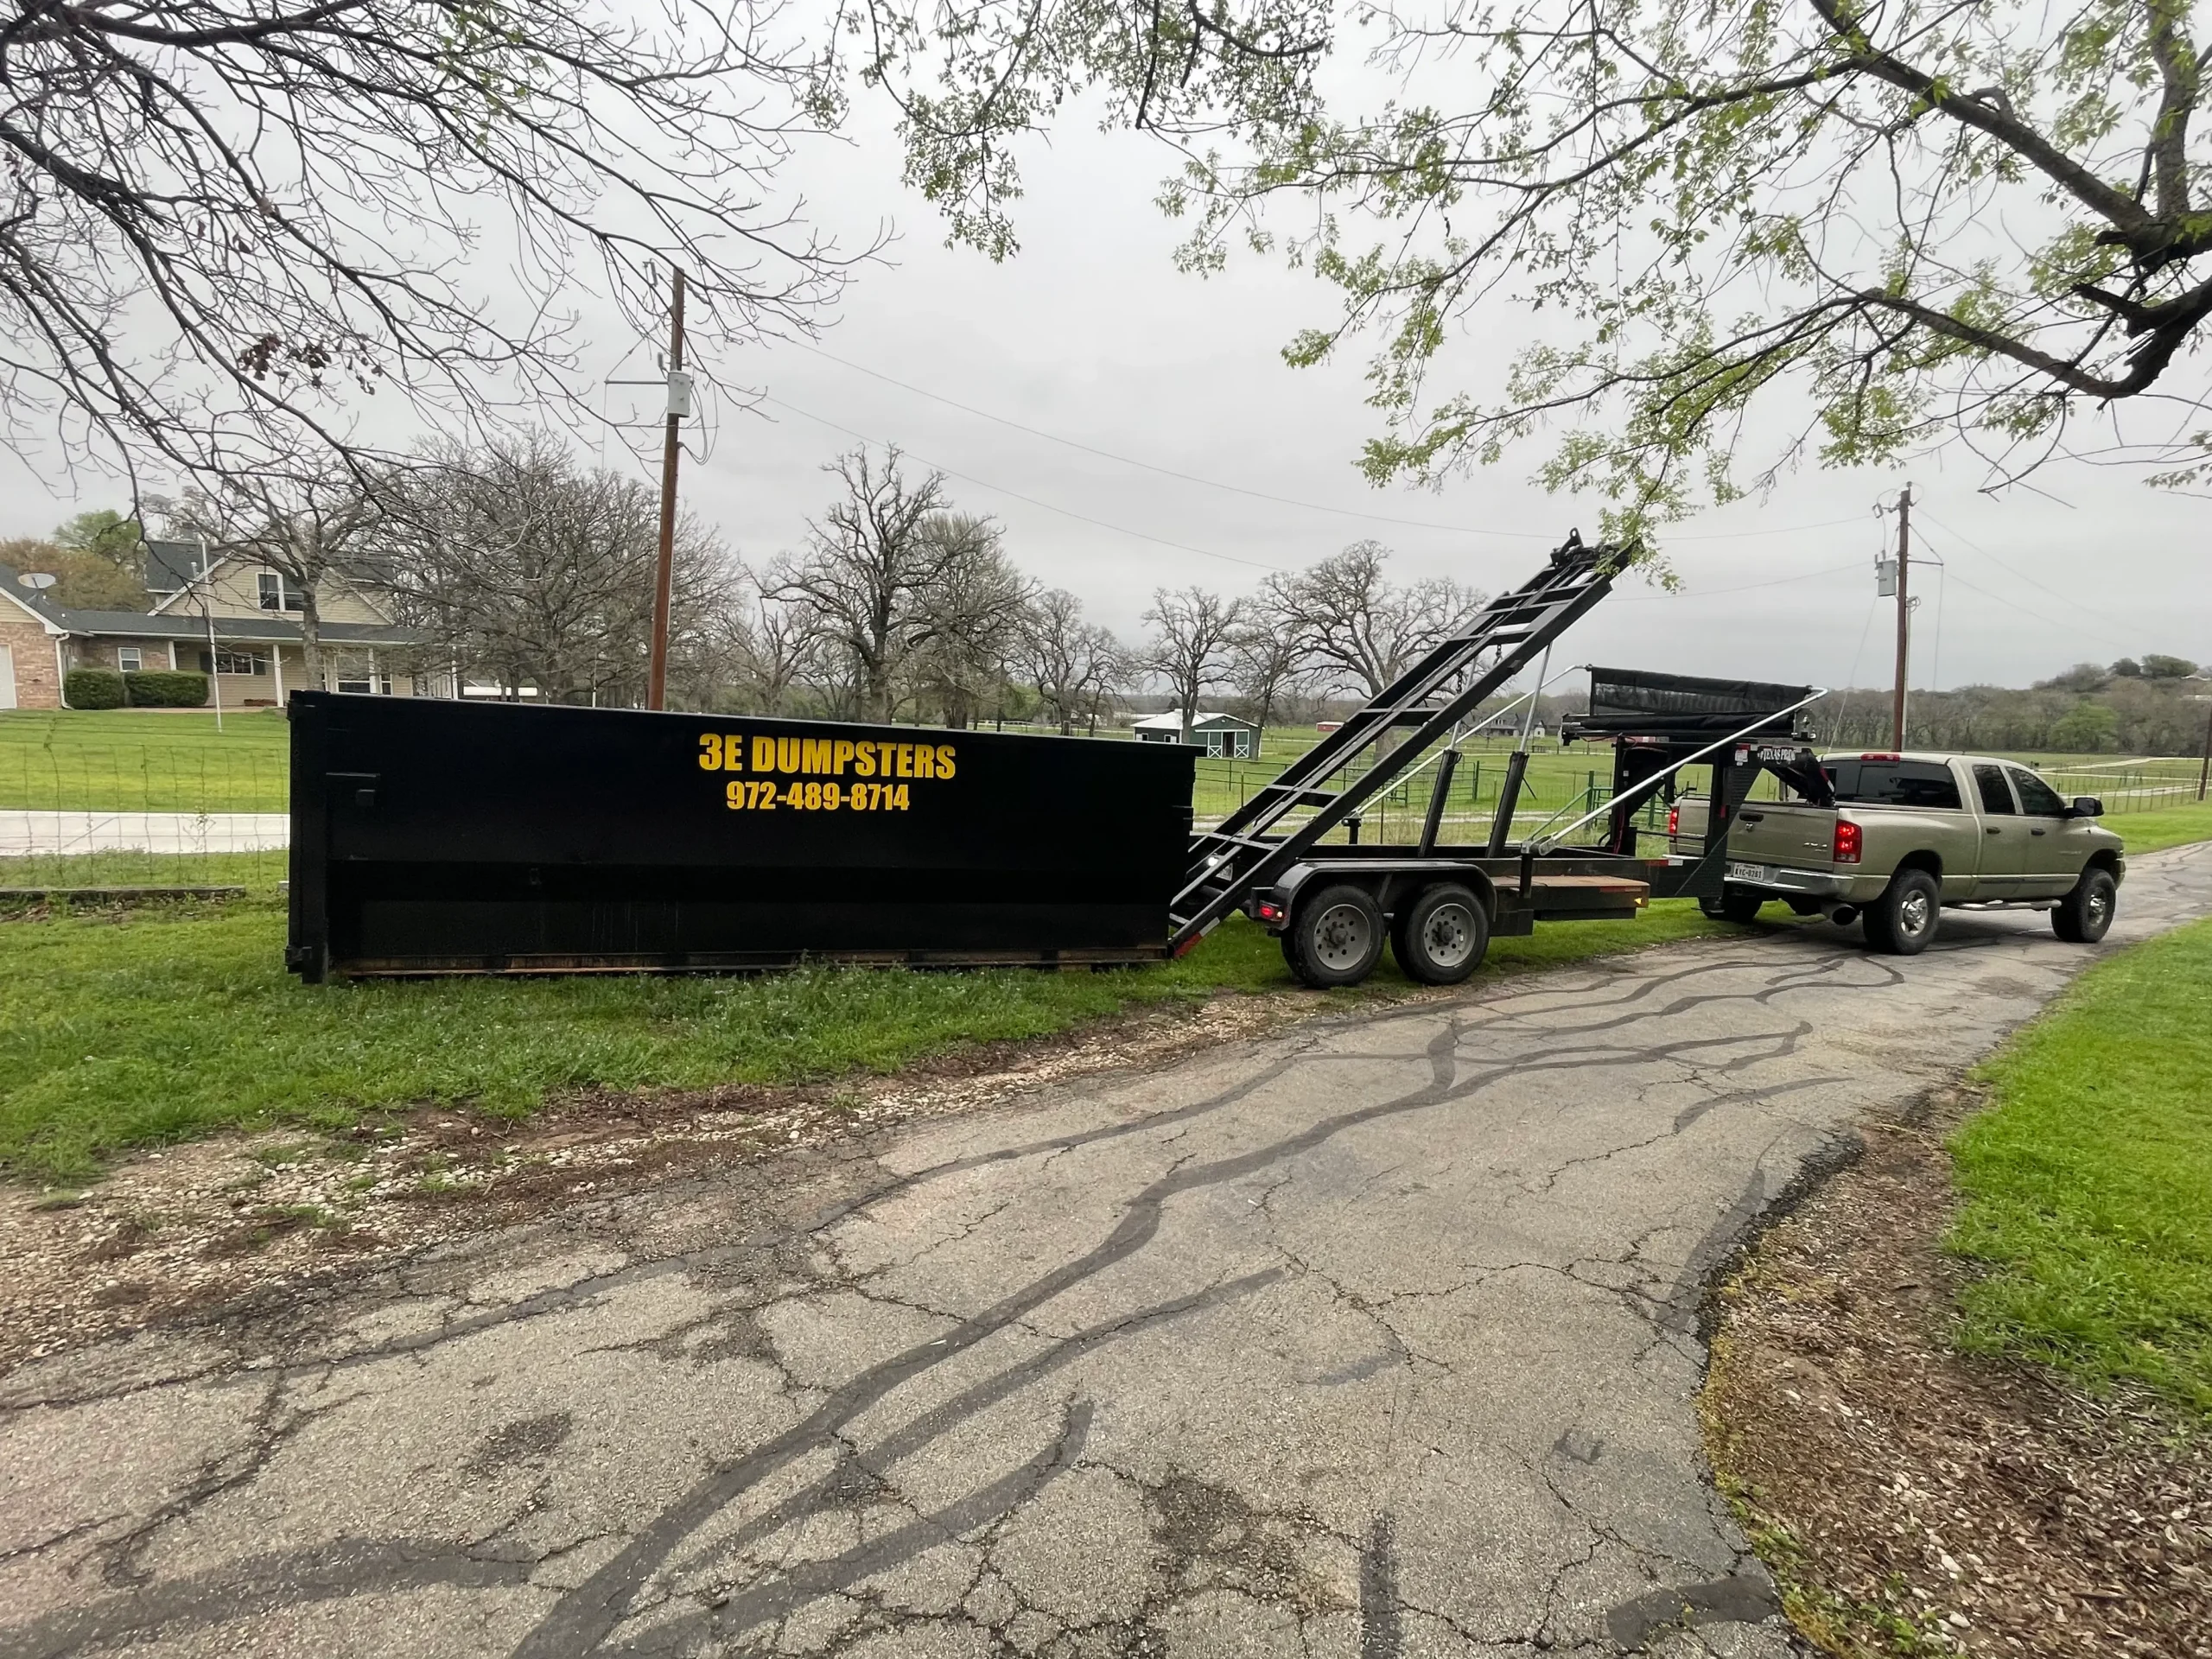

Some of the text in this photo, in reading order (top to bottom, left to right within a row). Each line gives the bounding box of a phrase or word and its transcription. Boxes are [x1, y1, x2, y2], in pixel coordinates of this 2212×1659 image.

[699, 733, 957, 779] 3E DUMPSTERS
[726, 781, 910, 810] 972-489-8714
